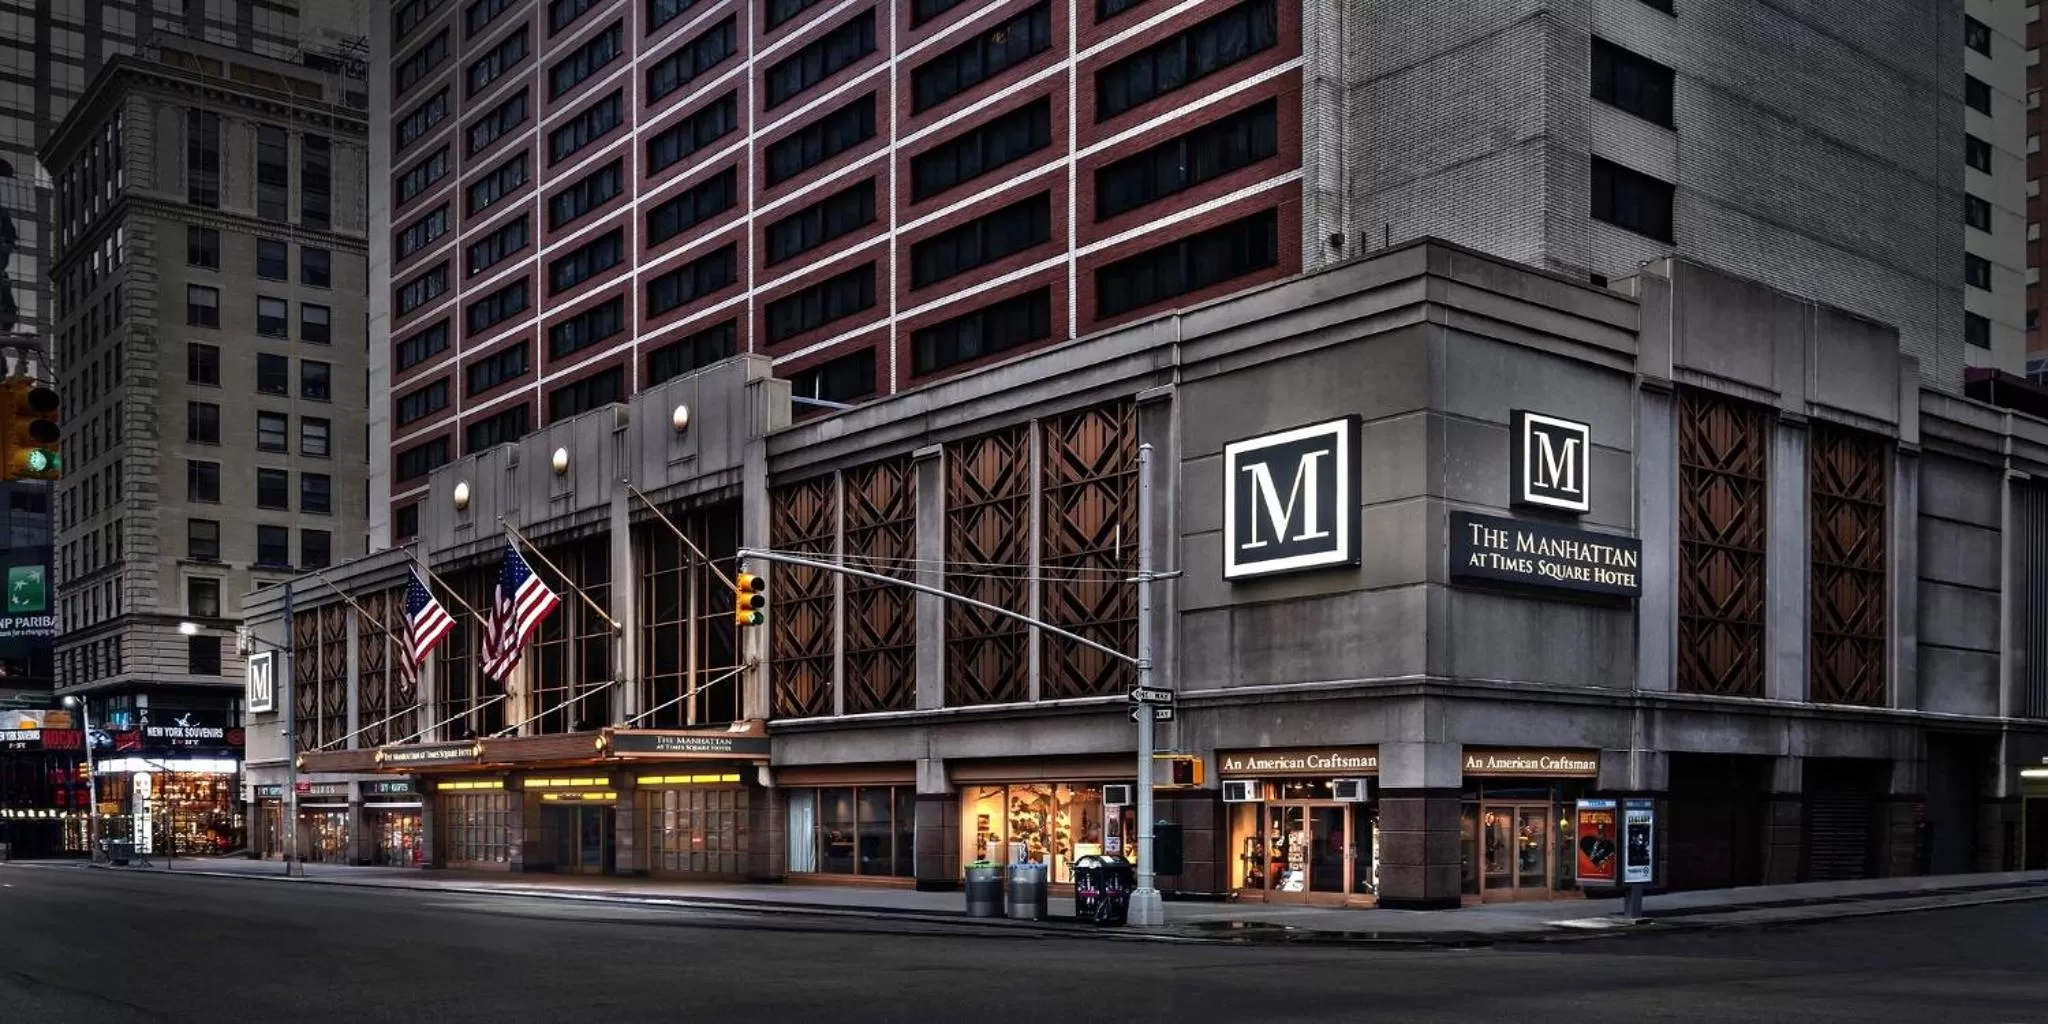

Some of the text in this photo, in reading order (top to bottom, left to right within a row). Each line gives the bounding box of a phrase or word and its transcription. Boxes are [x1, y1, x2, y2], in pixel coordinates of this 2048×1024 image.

[1533, 431, 1580, 494] M
[1242, 449, 1329, 550] M
[1468, 522, 1638, 568] THE MANHATTAN
[1469, 552, 1638, 588] AT TIMES SQUARE HOTEL
[251, 663, 269, 702] M
[147, 726, 223, 738] NEW YORK SOUVENIRS
[676, 736, 732, 745] MANHATTAN
[1224, 753, 1377, 770] An American Craftsman
[1466, 756, 1596, 769] An American Craftsman
